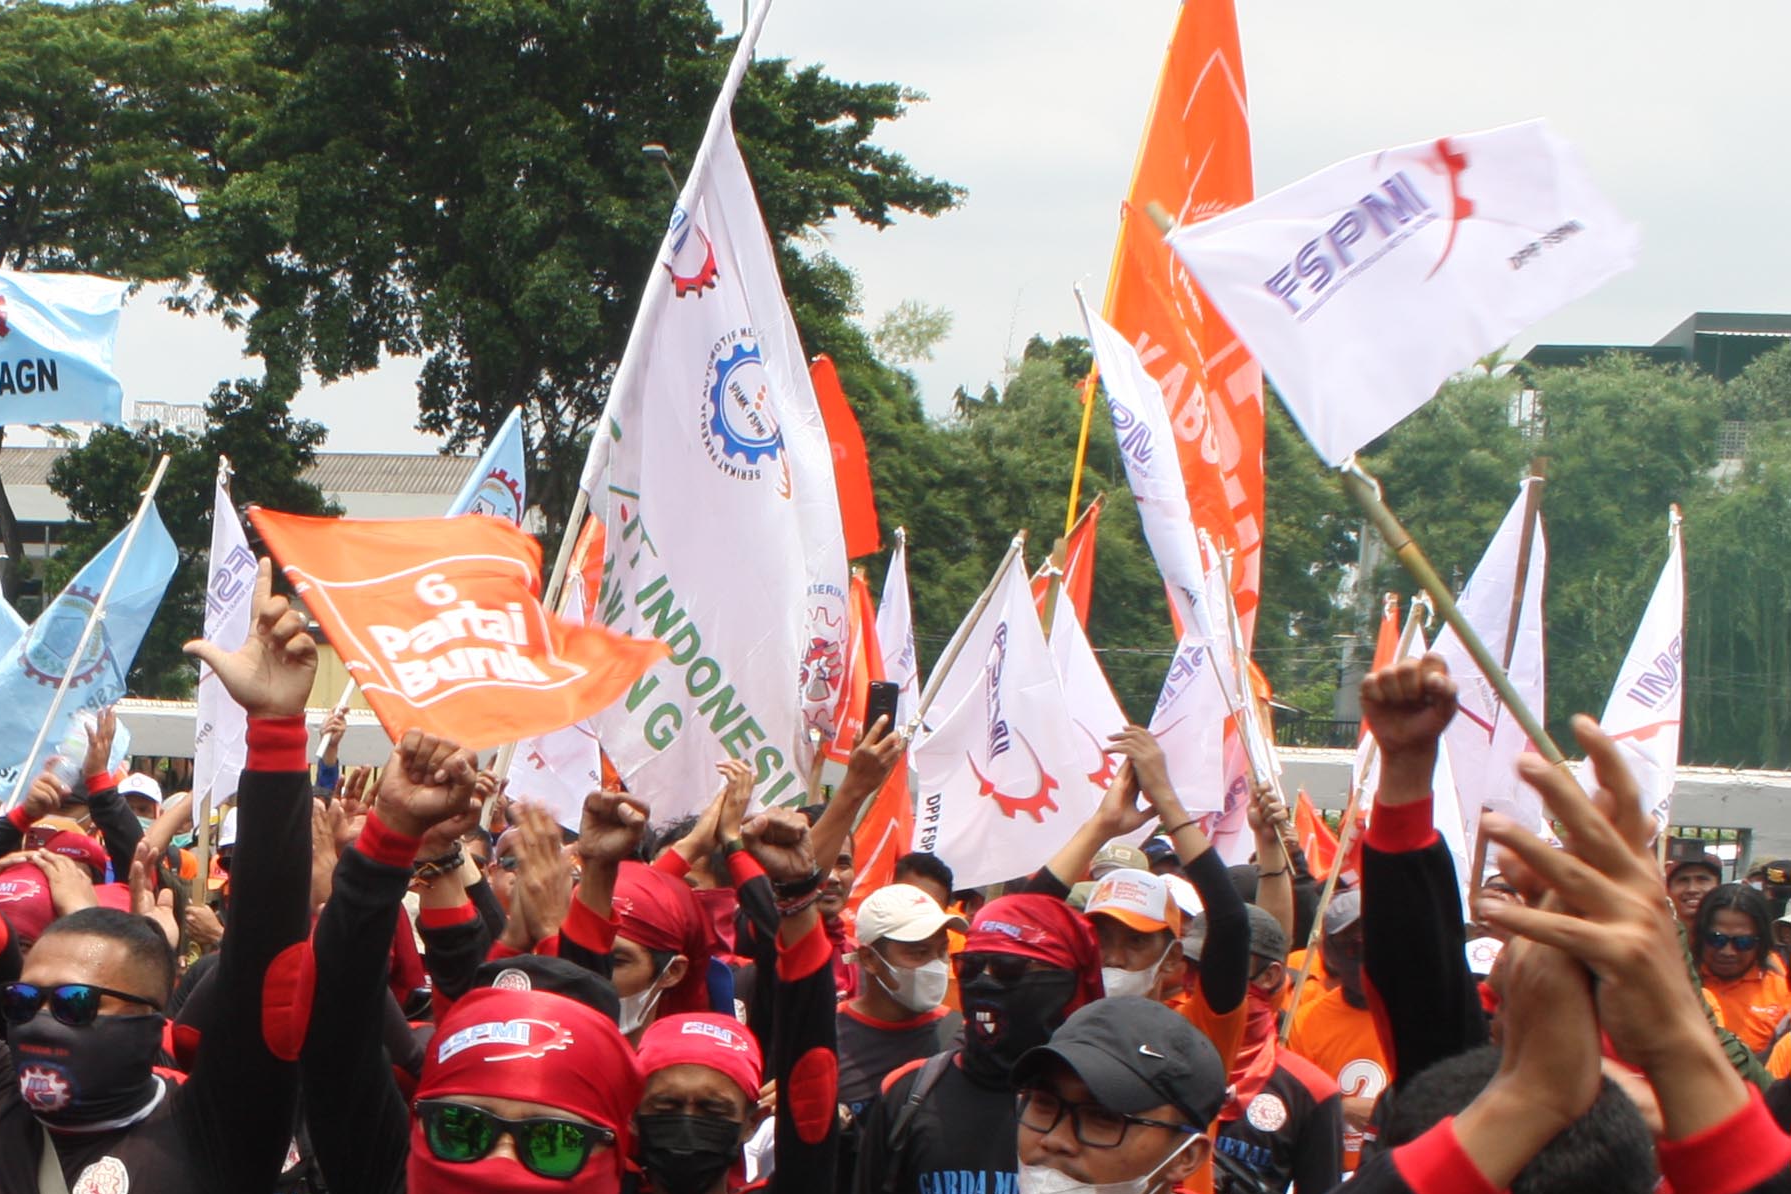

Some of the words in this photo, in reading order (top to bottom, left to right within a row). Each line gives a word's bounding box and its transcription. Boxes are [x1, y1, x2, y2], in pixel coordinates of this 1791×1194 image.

[1264, 170, 1432, 315] FSPMI
[414, 573, 458, 607] 6
[367, 599, 530, 662] Partai
[391, 644, 551, 700] Buruh
[925, 792, 942, 823] DPP
[438, 1020, 531, 1065] FSPMI
